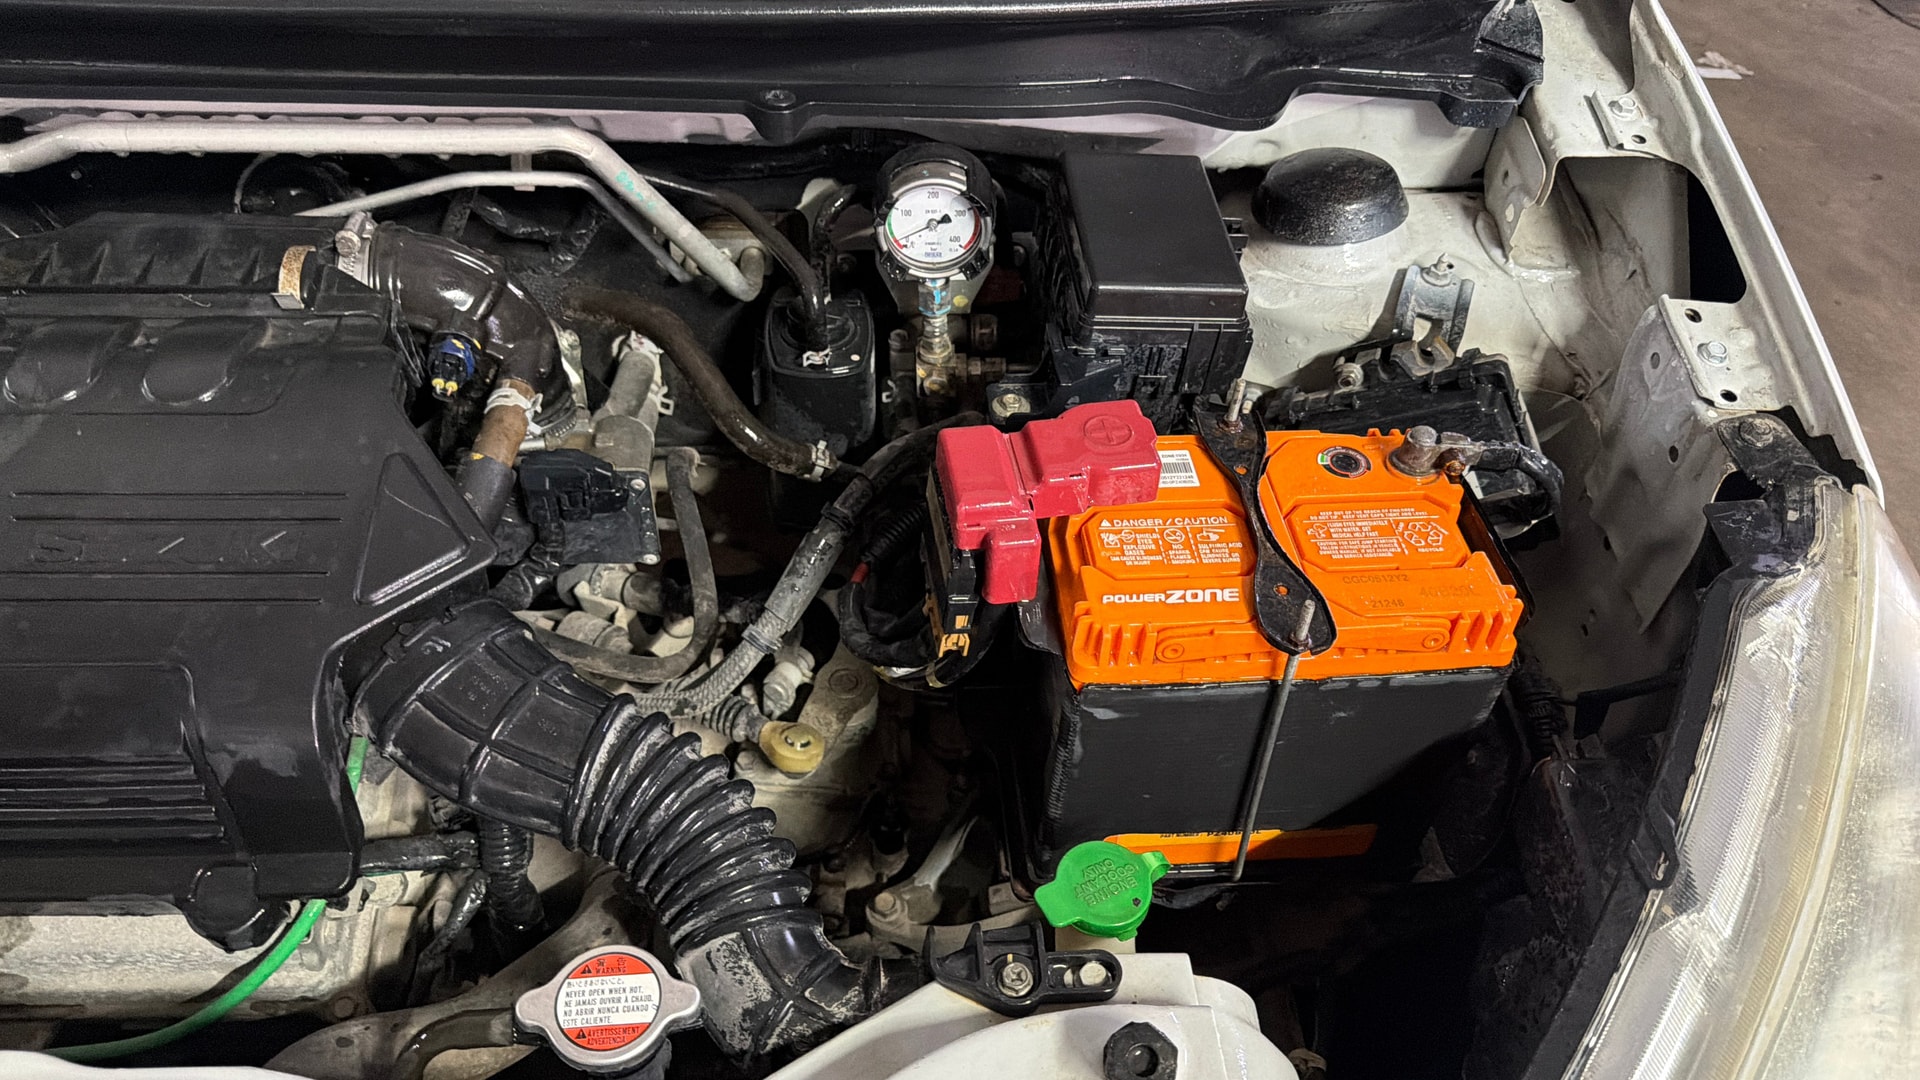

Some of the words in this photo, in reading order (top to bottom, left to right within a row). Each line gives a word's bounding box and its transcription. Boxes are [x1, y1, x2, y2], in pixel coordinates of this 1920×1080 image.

[1113, 518, 1163, 527] DANGER
[1175, 516, 1228, 525] CAUTION
[1371, 599, 1405, 608] 21248
[1083, 858, 1114, 879] ONLY
[1075, 863, 1136, 900] COOLANT
[1084, 875, 1138, 906] ENGINE
[565, 990, 586, 998] NEVER
[588, 988, 606, 996] OPEN
[575, 998, 597, 1006] JAMAIS
[624, 993, 629, 1002] À
[575, 1008, 595, 1016] ABRIR
[597, 1006, 620, 1014] NUNCA
[622, 1004, 649, 1013] CUANDO
[587, 1026, 640, 1037] AVERTISSEMENT
[587, 1036, 626, 1045] ADVERTENCIA
